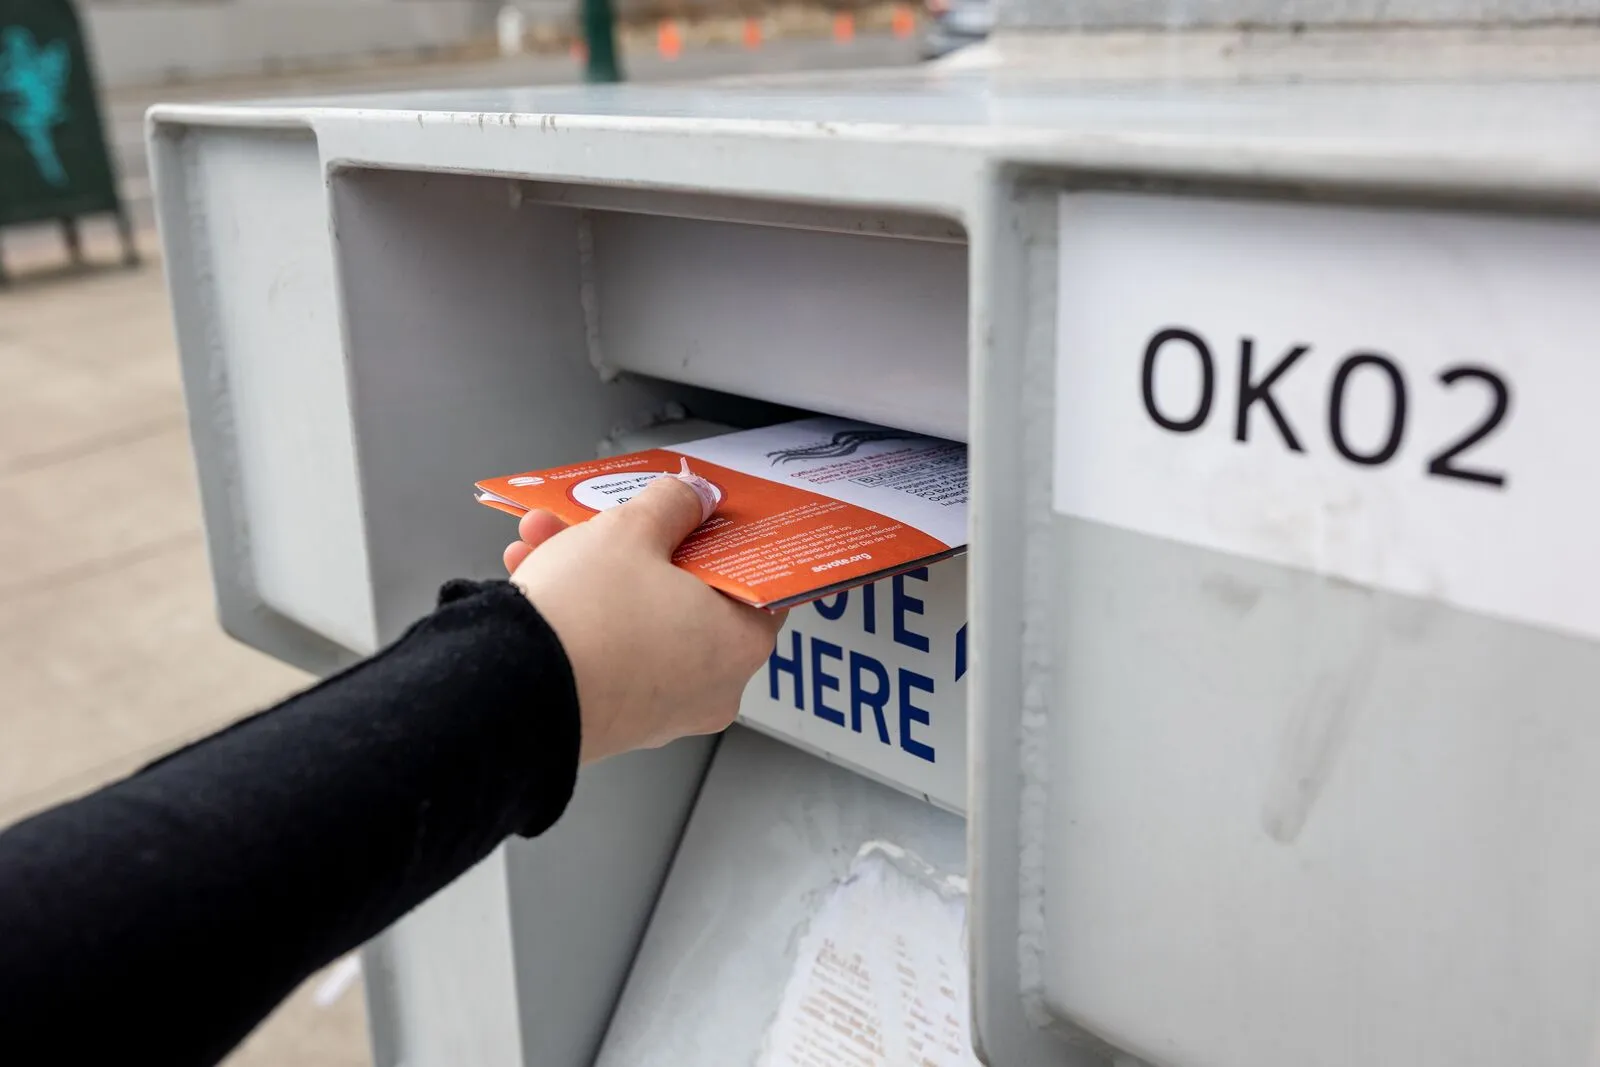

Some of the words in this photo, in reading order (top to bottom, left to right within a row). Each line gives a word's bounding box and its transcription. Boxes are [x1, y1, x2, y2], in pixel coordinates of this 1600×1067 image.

[549, 468, 599, 480] Registrar
[591, 480, 632, 491] Return
[632, 475, 656, 484] your
[602, 485, 637, 495] ballot
[811, 552, 872, 573] acvote.org
[811, 567, 930, 654] TE
[769, 630, 936, 764] HERE
